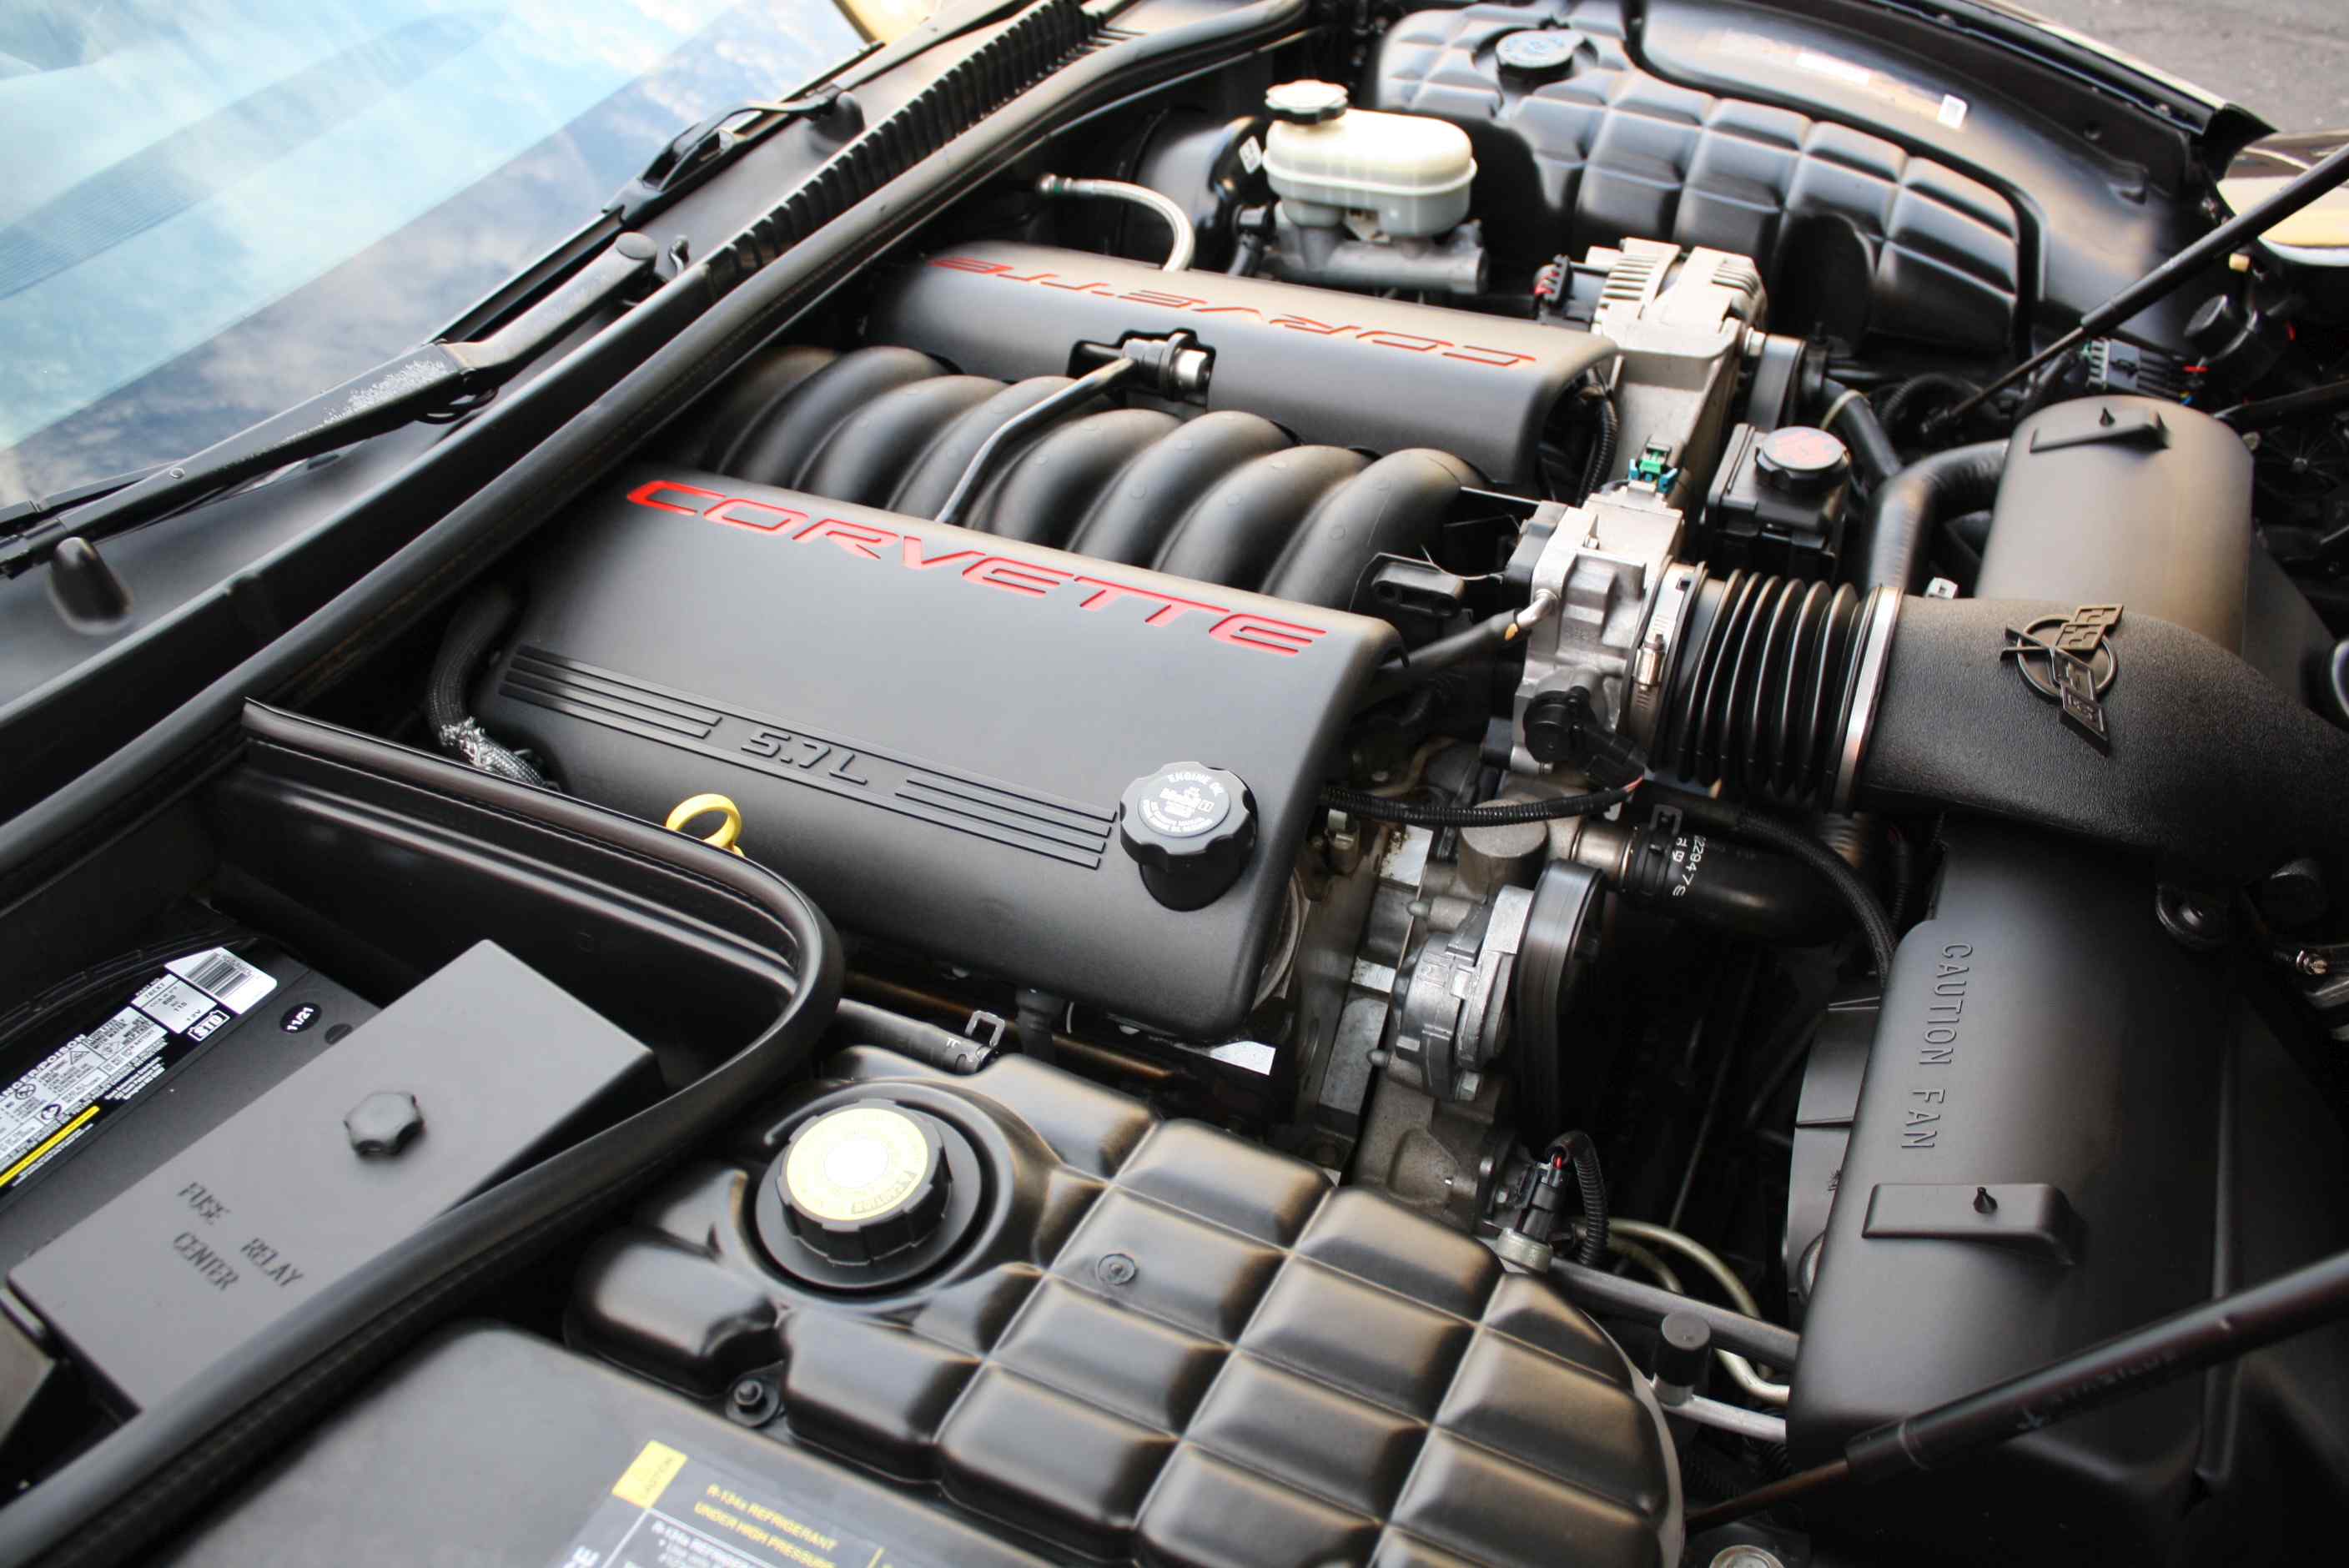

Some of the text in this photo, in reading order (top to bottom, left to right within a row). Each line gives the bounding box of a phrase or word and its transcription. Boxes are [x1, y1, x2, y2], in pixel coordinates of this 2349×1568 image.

[928, 257, 1537, 367] CORVETTE
[626, 479, 1328, 657] CORVETTE
[740, 727, 868, 786] 5.7L
[1167, 771, 1210, 785] ENGINE
[194, 1014, 223, 1036] STD
[286, 1007, 314, 1032] 11/21
[1901, 942, 1973, 1150] CAUTION FAN
[174, 1231, 240, 1292] CENTER
[178, 1182, 304, 1287] FUSE RELAY
